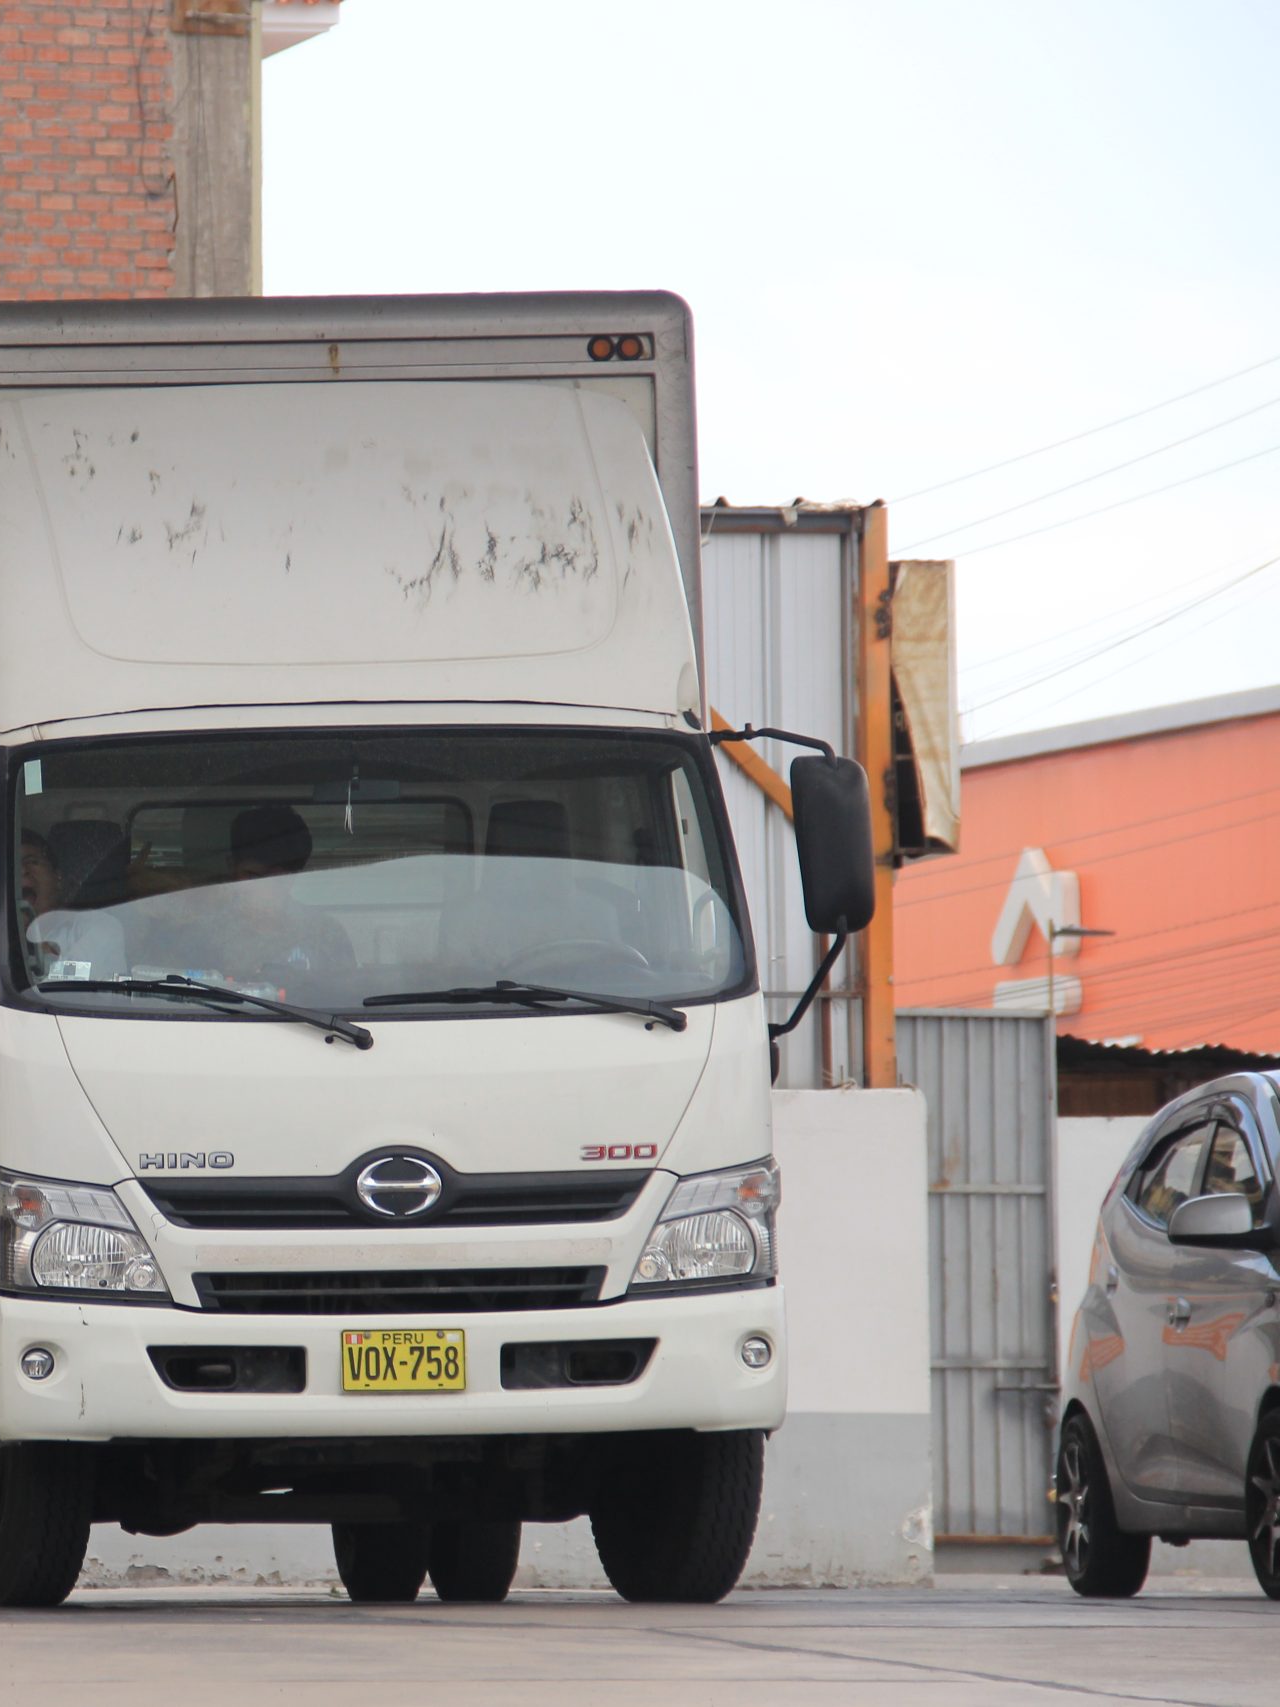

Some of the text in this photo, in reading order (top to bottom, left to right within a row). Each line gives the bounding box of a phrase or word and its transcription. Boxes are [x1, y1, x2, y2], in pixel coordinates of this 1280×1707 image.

[138, 1151, 235, 1170] HINO
[580, 1143, 658, 1161] 300
[382, 1333, 424, 1345] PERU
